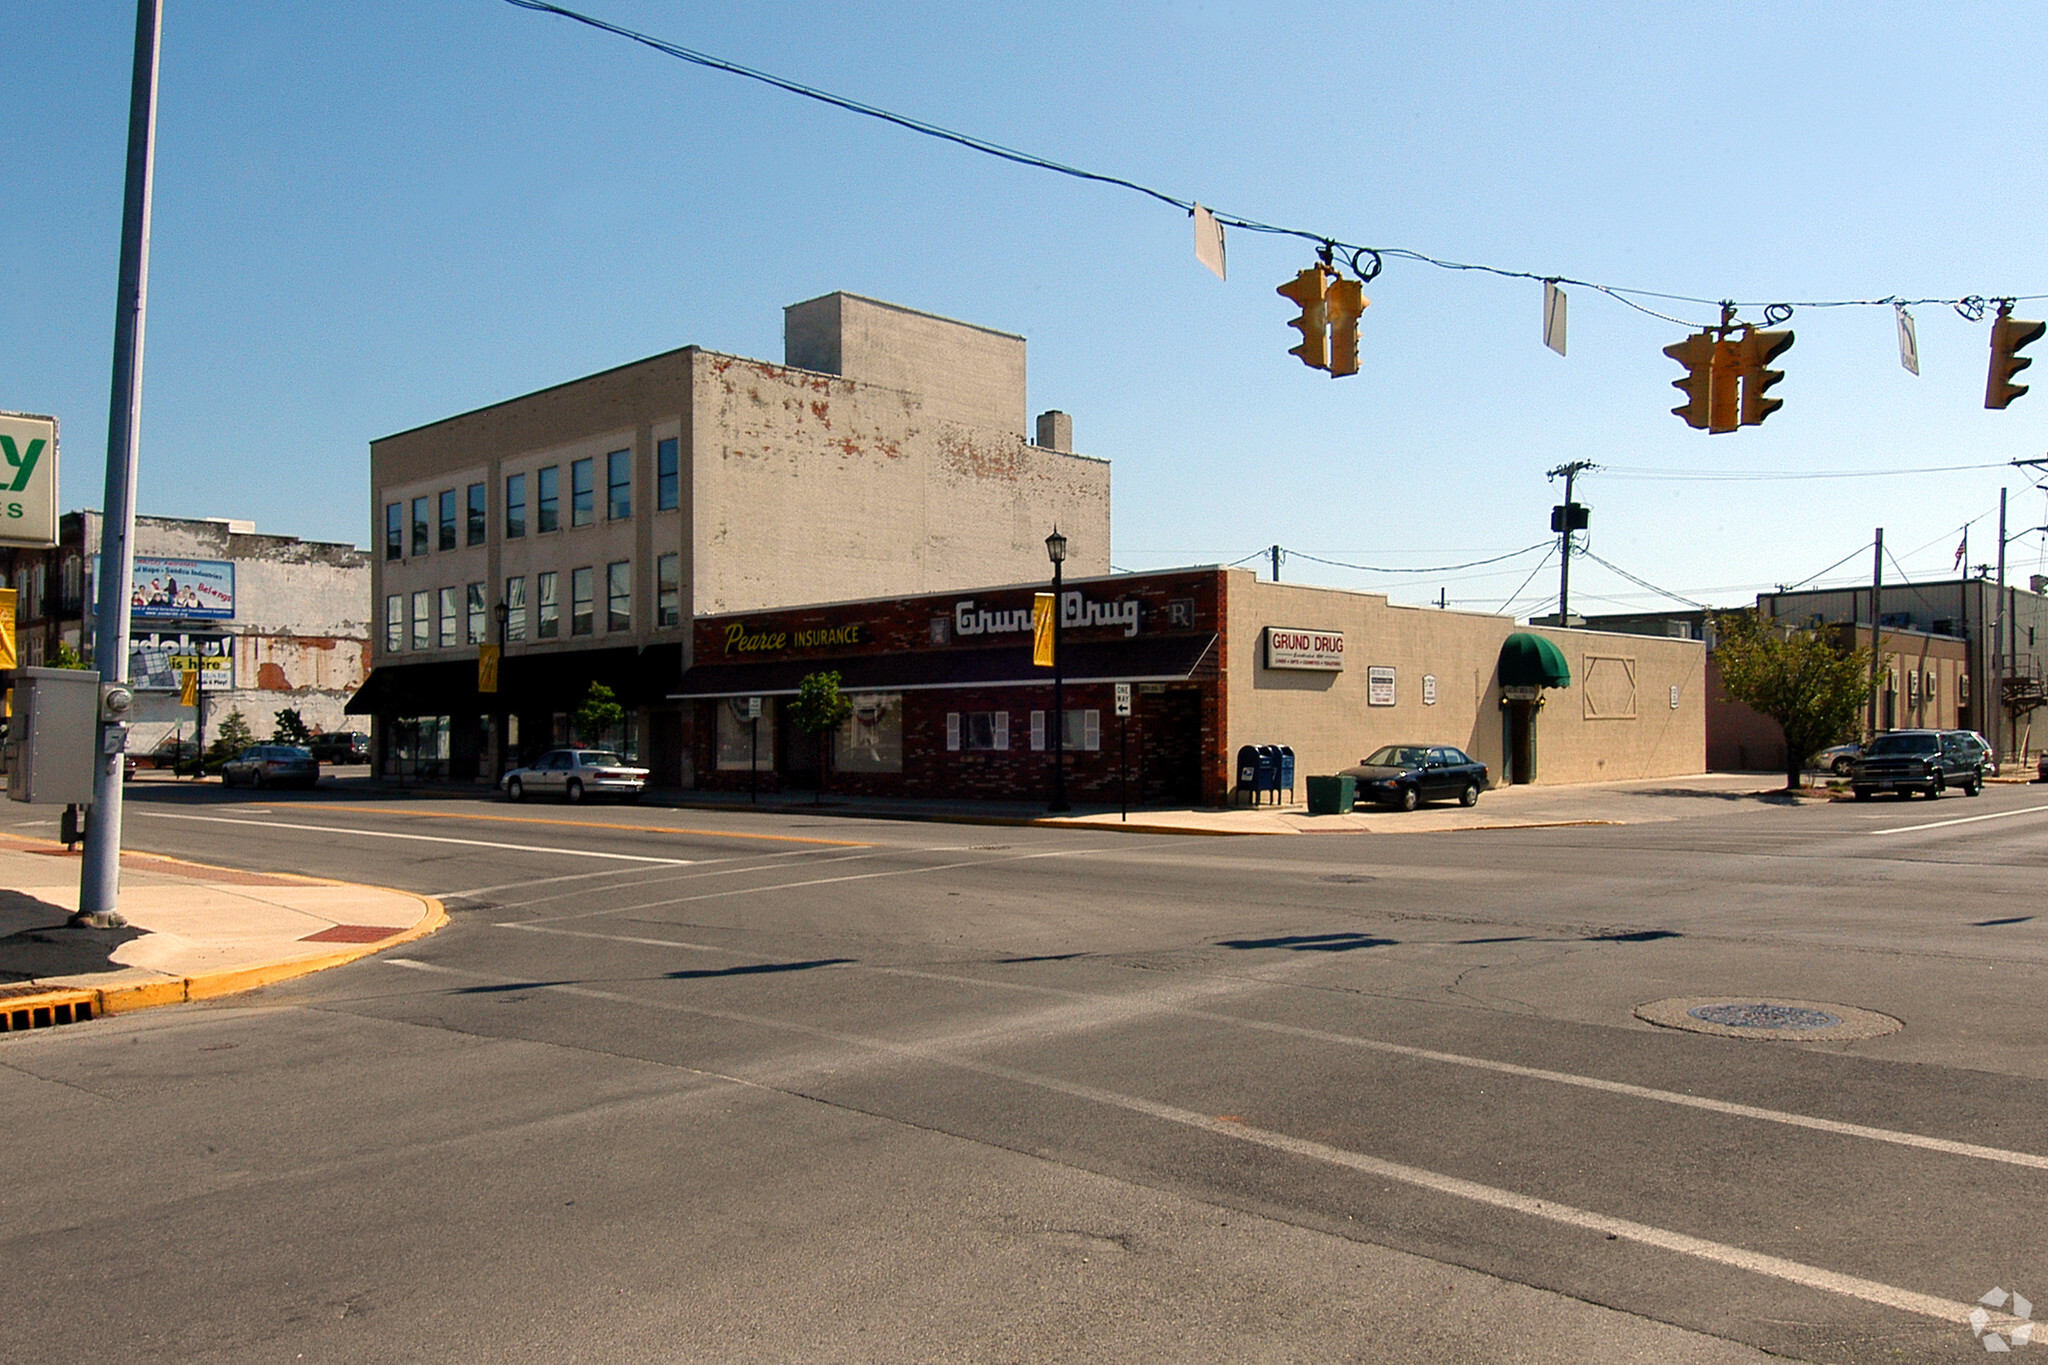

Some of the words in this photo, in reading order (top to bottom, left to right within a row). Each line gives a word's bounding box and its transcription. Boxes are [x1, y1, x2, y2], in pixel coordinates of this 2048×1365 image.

[956, 600, 1035, 635] Grun
[1061, 591, 1139, 637] Drug
[725, 623, 786, 654] Pearce
[794, 626, 859, 647] INSURANCE
[1273, 633, 1310, 650] GRUND
[1315, 636, 1343, 653] DRUG
[130, 633, 232, 669] udoku!
[172, 658, 183, 669] is
[1116, 686, 1129, 694] ONE
[1117, 695, 1129, 703] WAY
